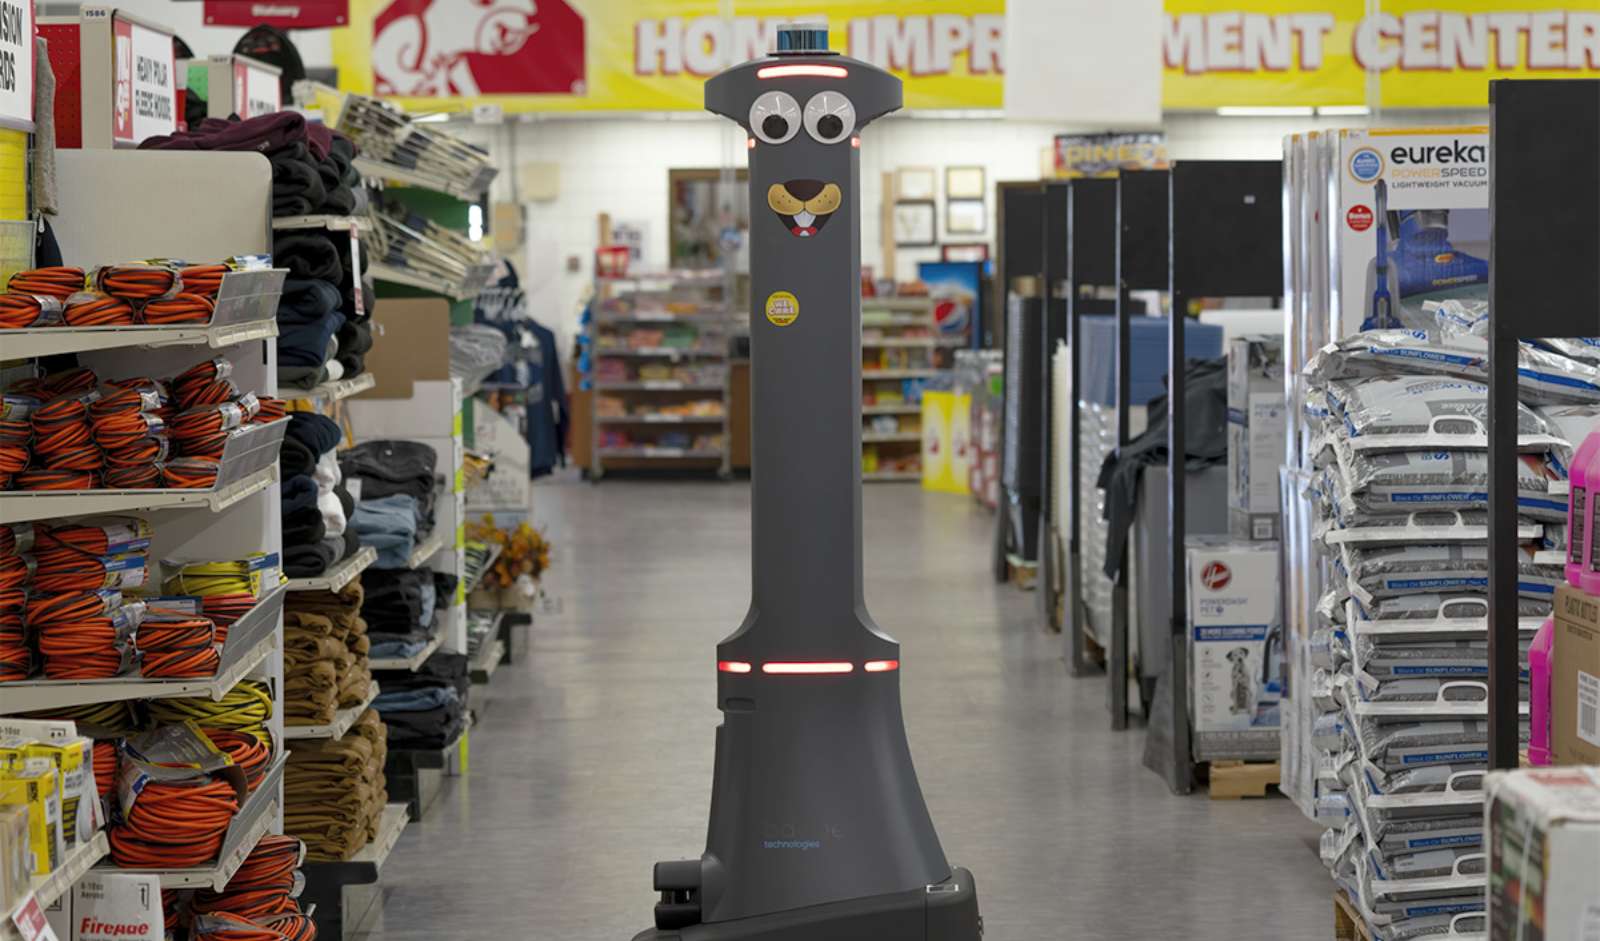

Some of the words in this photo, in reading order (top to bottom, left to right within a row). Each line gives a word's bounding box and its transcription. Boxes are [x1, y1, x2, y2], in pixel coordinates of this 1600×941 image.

[0, 1, 22, 47] SION
[1390, 139, 1486, 165] eureka
[1391, 167, 1488, 178] POWERSPEED
[1391, 180, 1451, 189] LIGHTWEIGHT
[1452, 180, 1488, 188] VACUUM
[1422, 493, 1470, 502] SUNFLOWER
[1419, 579, 1466, 587] SUNFLOWER
[1424, 666, 1473, 674] SUNFLOWER
[763, 839, 820, 851] technologies
